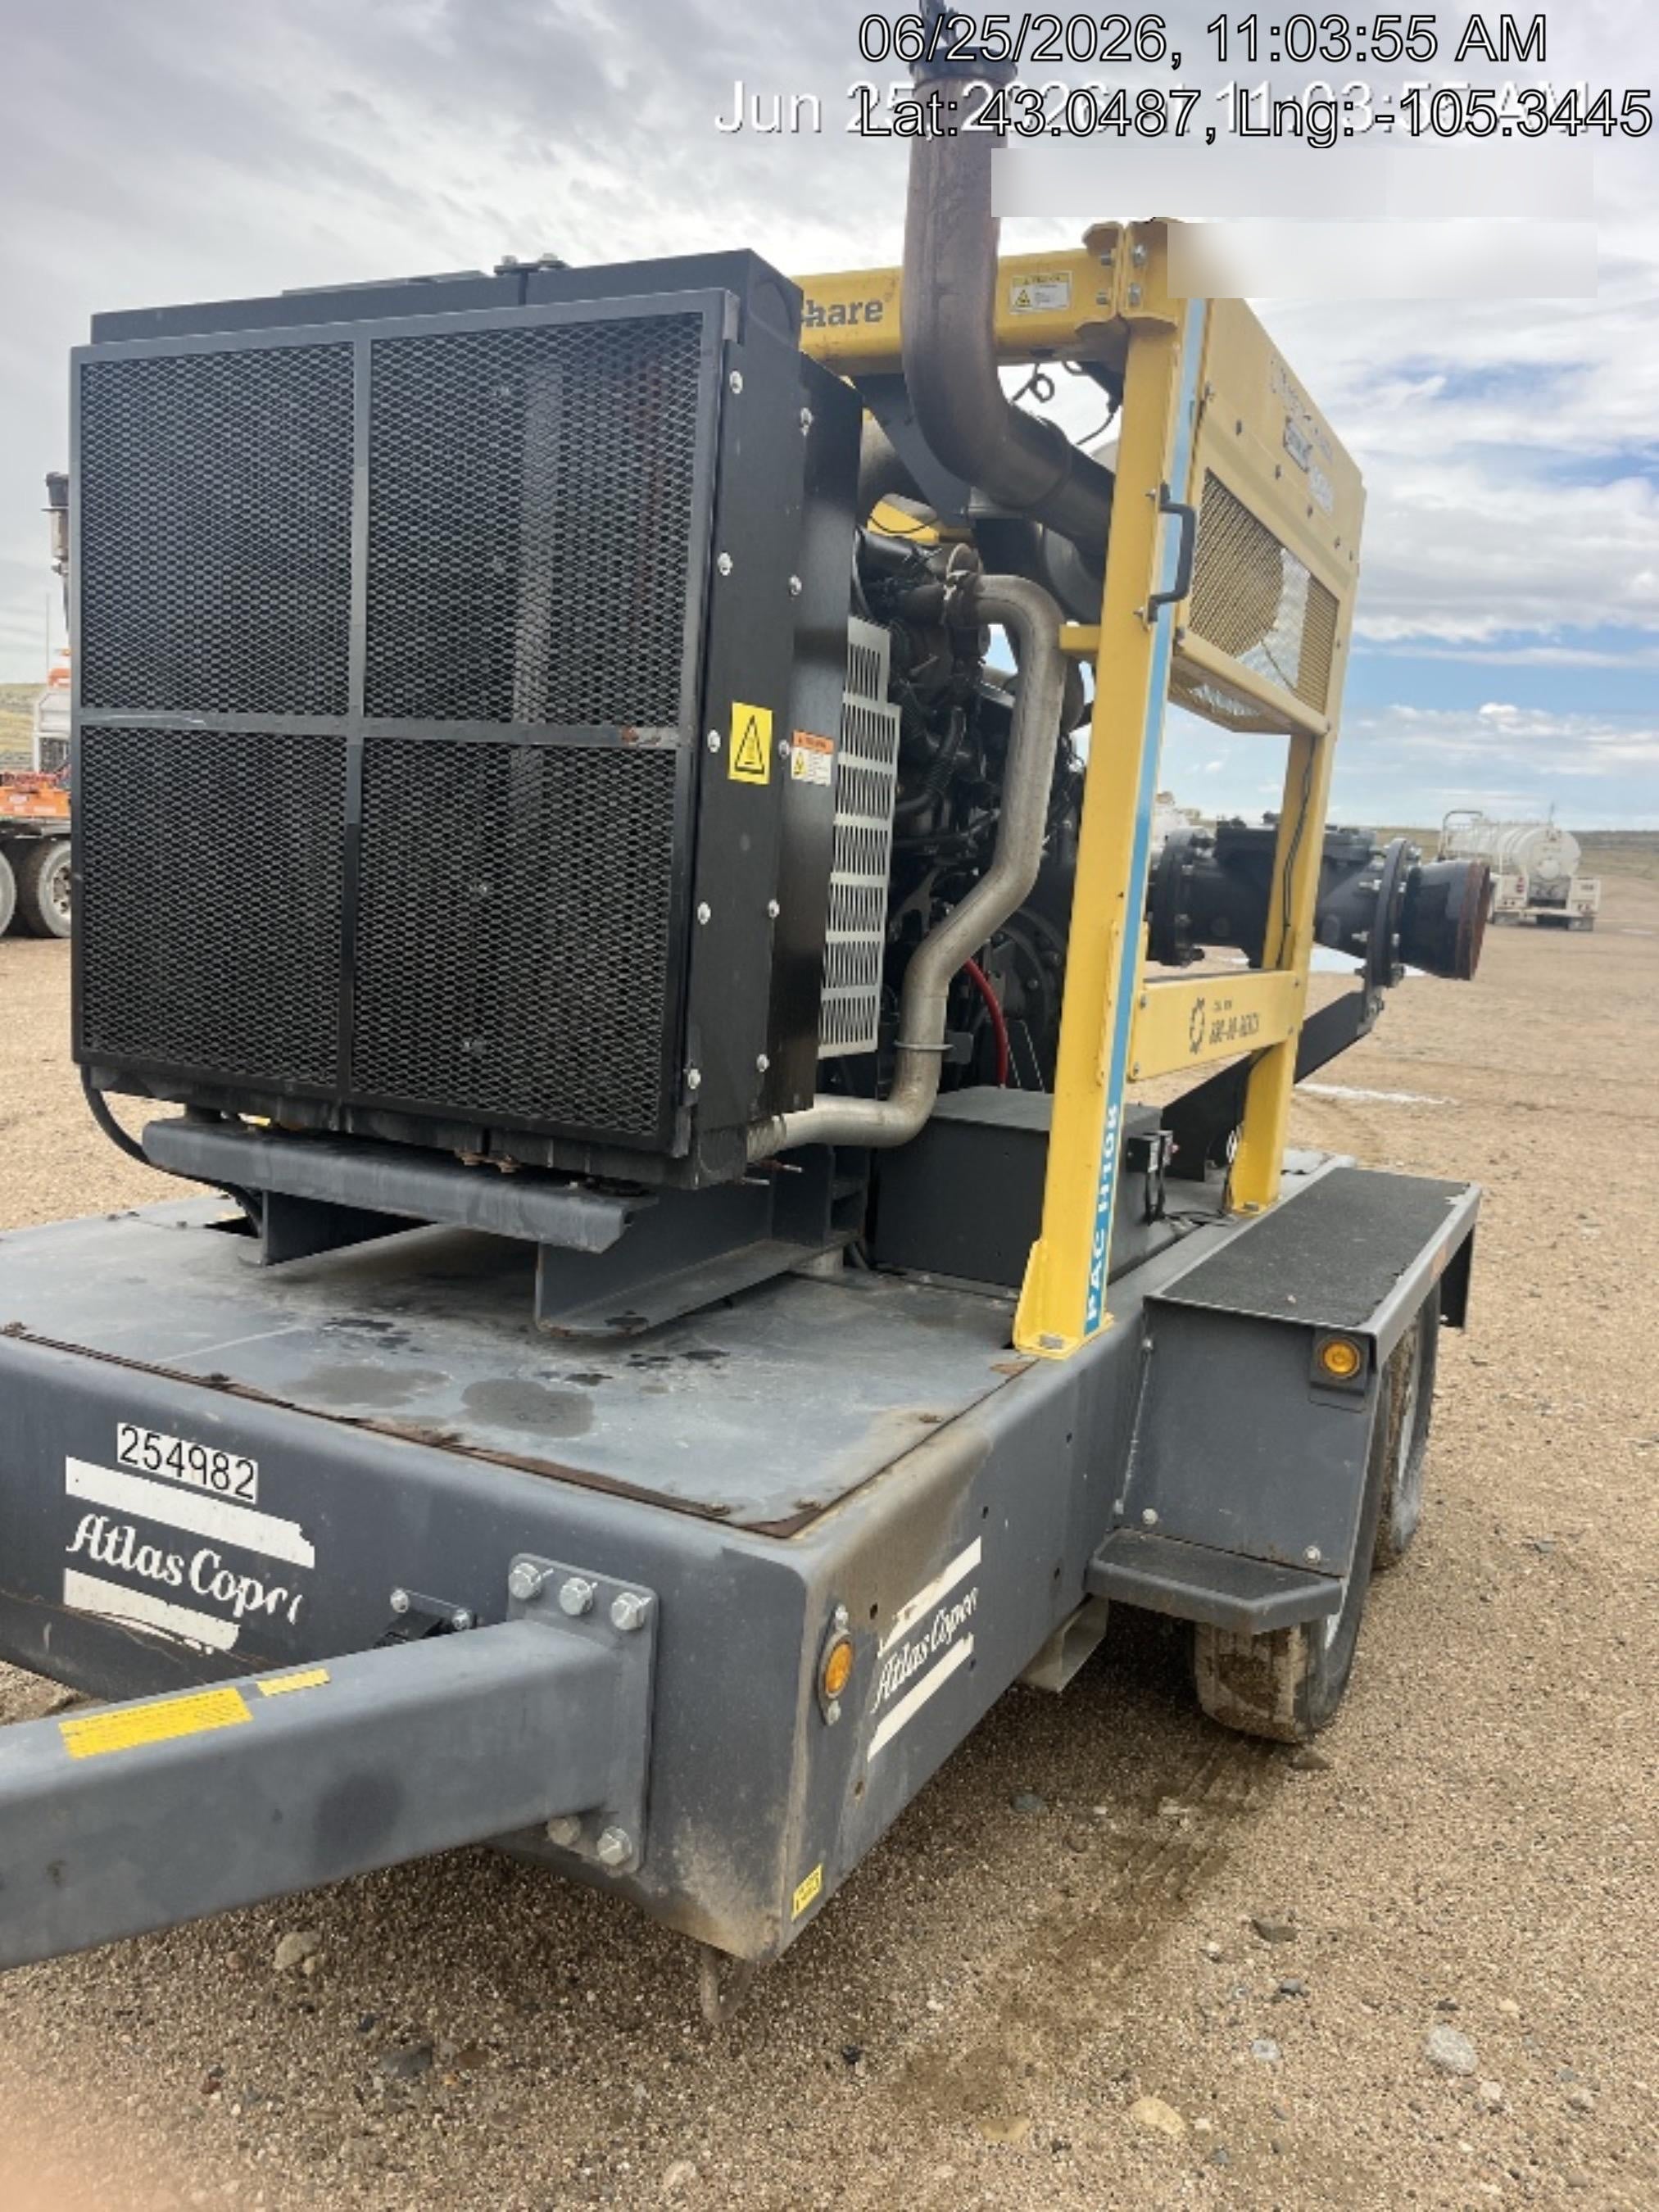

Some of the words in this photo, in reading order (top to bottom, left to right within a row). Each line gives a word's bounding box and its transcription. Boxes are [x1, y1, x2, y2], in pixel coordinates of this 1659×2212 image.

[801, 300, 884, 327] hare
[1086, 1228, 1106, 1321] PAC
[120, 1426, 254, 1500] 254982
[66, 1513, 184, 1586] Atlas
[870, 1634, 931, 1714] Atlas
